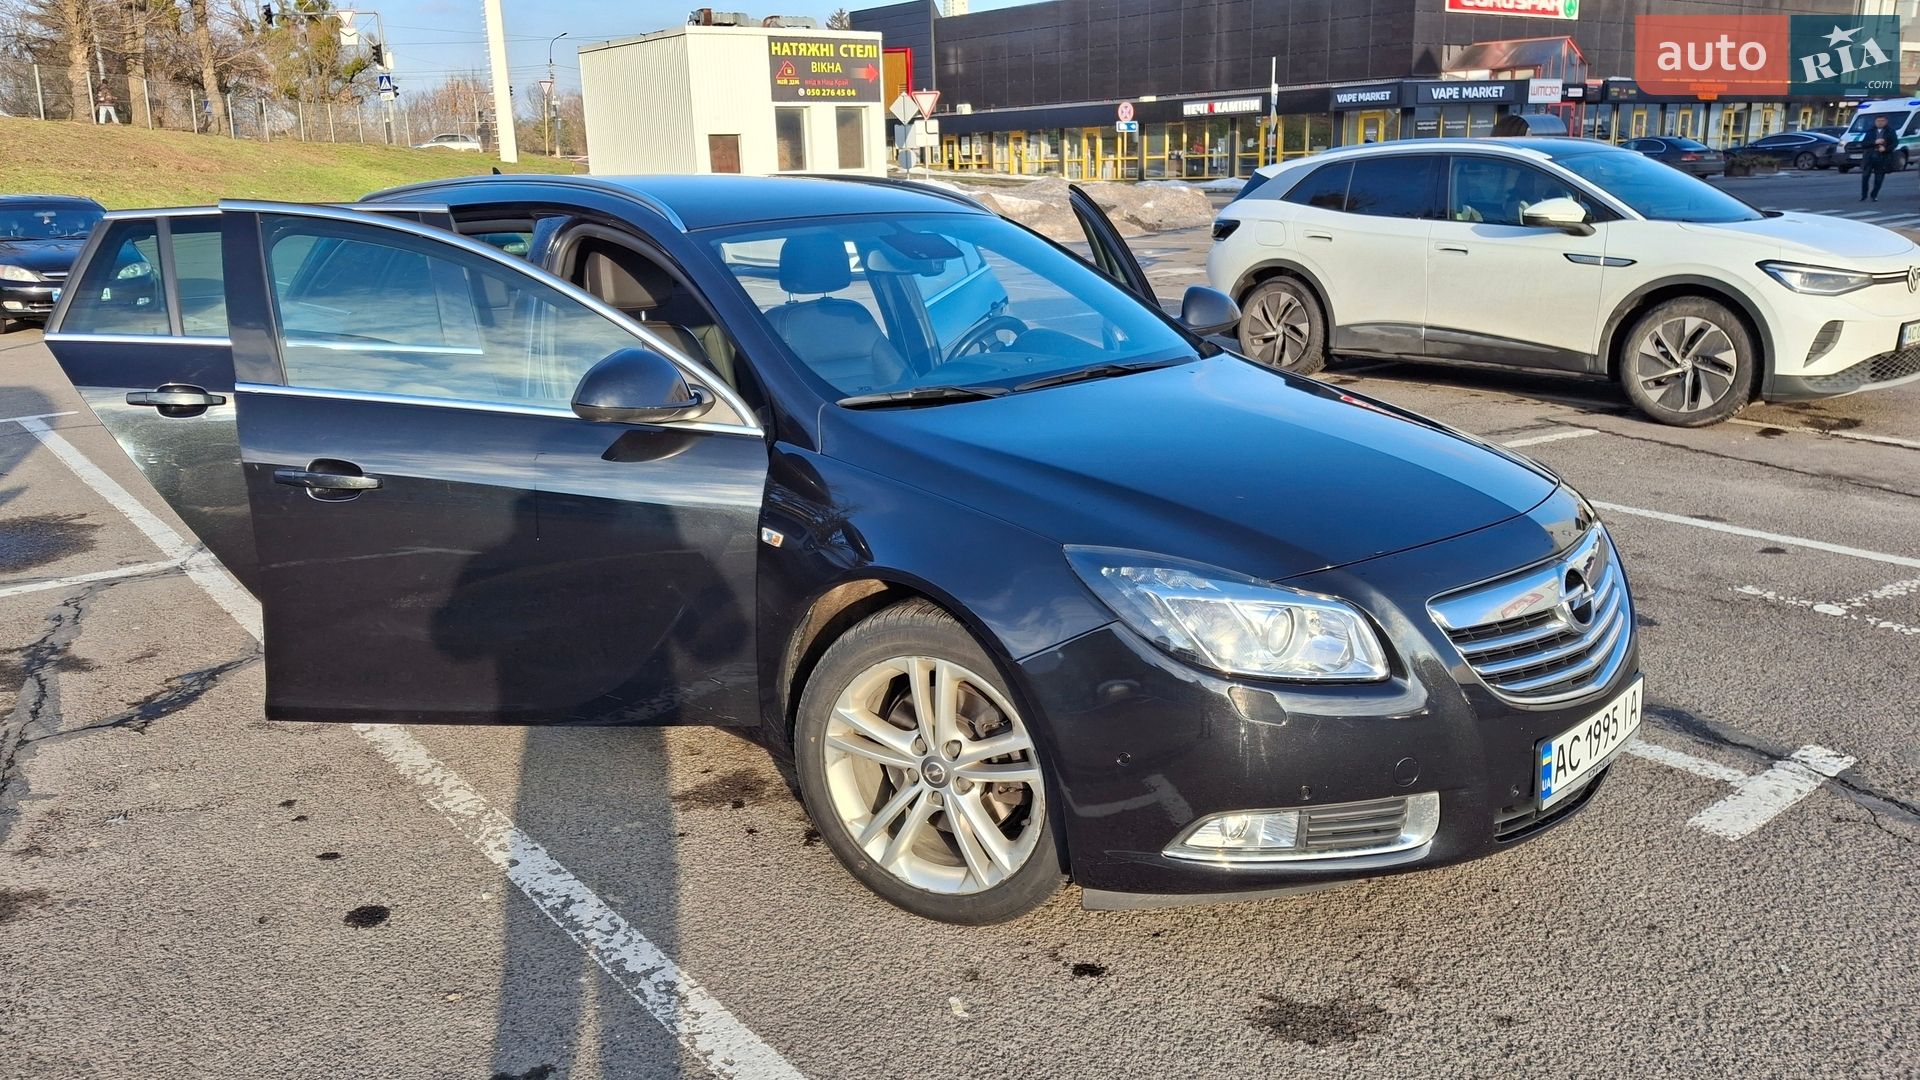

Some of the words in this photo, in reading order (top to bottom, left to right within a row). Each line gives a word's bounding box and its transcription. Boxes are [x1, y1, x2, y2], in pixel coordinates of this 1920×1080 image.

[771, 41, 834, 57] НАТЯЖНІ
[839, 44, 878, 58] СТЕЛІ
[811, 61, 842, 73] ВІКНА
[806, 88, 820, 96] 050
[821, 88, 835, 96] 276
[836, 88, 846, 96] 45
[846, 88, 857, 96] 04
[1336, 93, 1358, 103] VAPE
[1358, 91, 1391, 102] MARKET
[1431, 87, 1460, 100] VAPE
[1462, 86, 1505, 99] MARKET
[1554, 734, 1581, 785] AC
[1585, 705, 1618, 760] 1995
[1624, 689, 1637, 731] IA
[1542, 777, 1551, 792] UA
